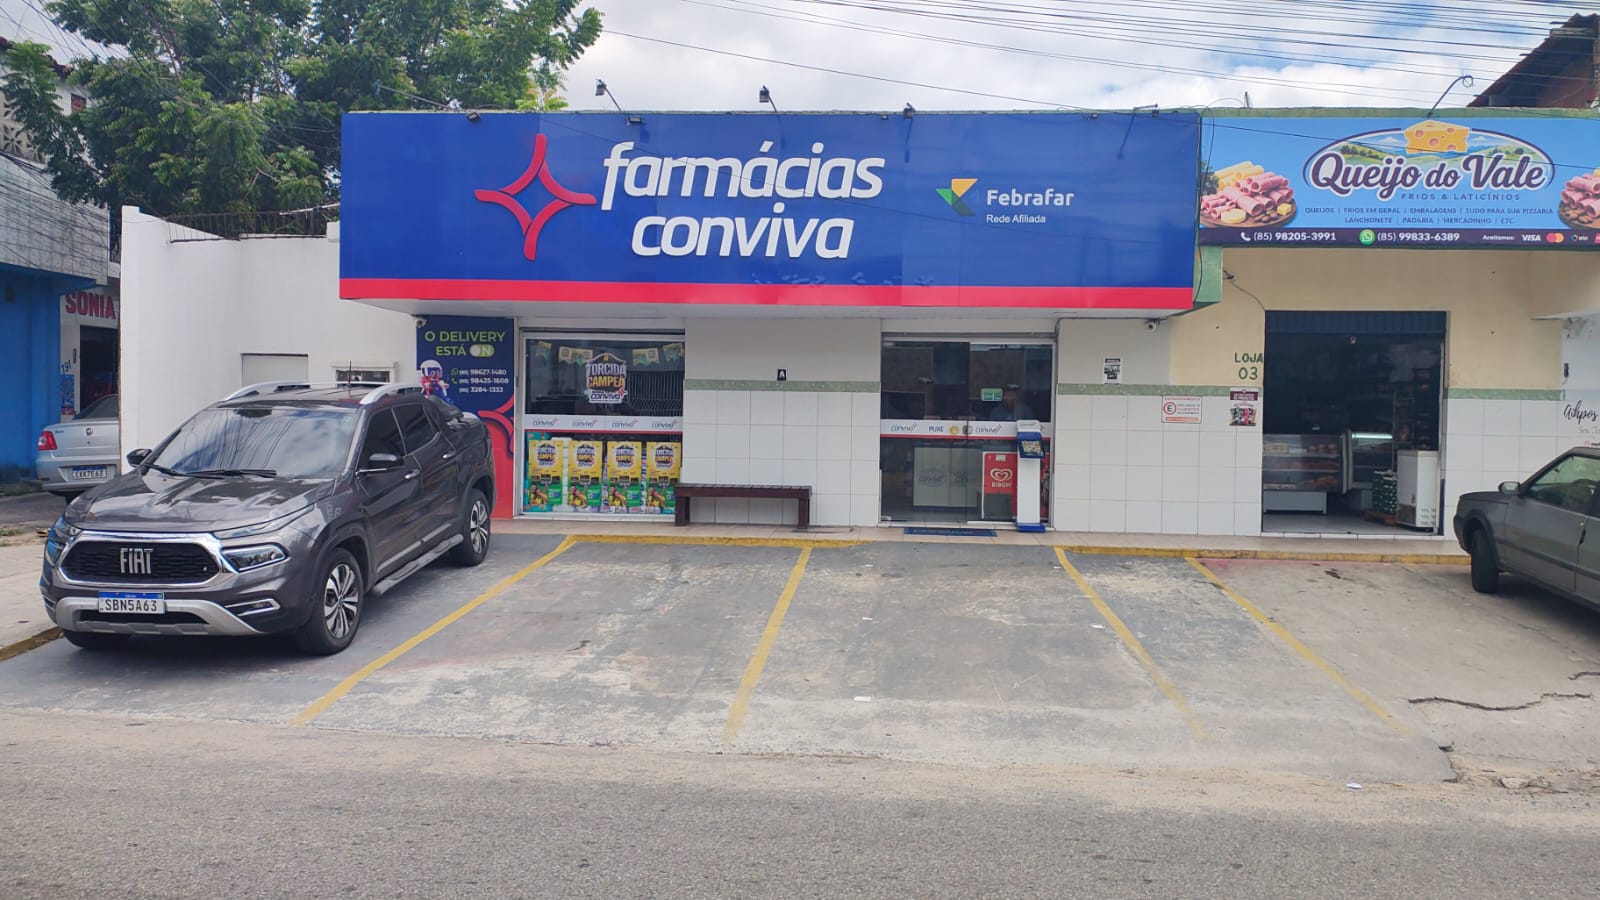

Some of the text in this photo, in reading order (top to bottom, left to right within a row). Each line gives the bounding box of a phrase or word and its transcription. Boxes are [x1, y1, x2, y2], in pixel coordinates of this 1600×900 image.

[602, 141, 886, 211] farmácias
[1311, 153, 1546, 198] Queijo do Vale
[986, 188, 1075, 206] Febrafar
[1453, 192, 1521, 201] LATICÍNIOS
[1304, 207, 1335, 215] QUEIJOS
[1409, 207, 1457, 215] EMBALAGENS
[986, 214, 1047, 223] Rede Afiliada
[631, 202, 855, 259] conviva
[1253, 231, 1337, 242] (85) 98205-3991
[1377, 232, 1460, 242] (85) 99833-6389
[424, 331, 506, 342] O DELIVERY
[436, 343, 467, 356] ESTÁ
[1234, 352, 1264, 363] LOJA
[586, 363, 626, 376] TORCIDA
[1238, 366, 1258, 380] 03
[1167, 404, 1173, 412] E
[120, 548, 154, 574] FIAT
[105, 599, 158, 612] SBN5A63
